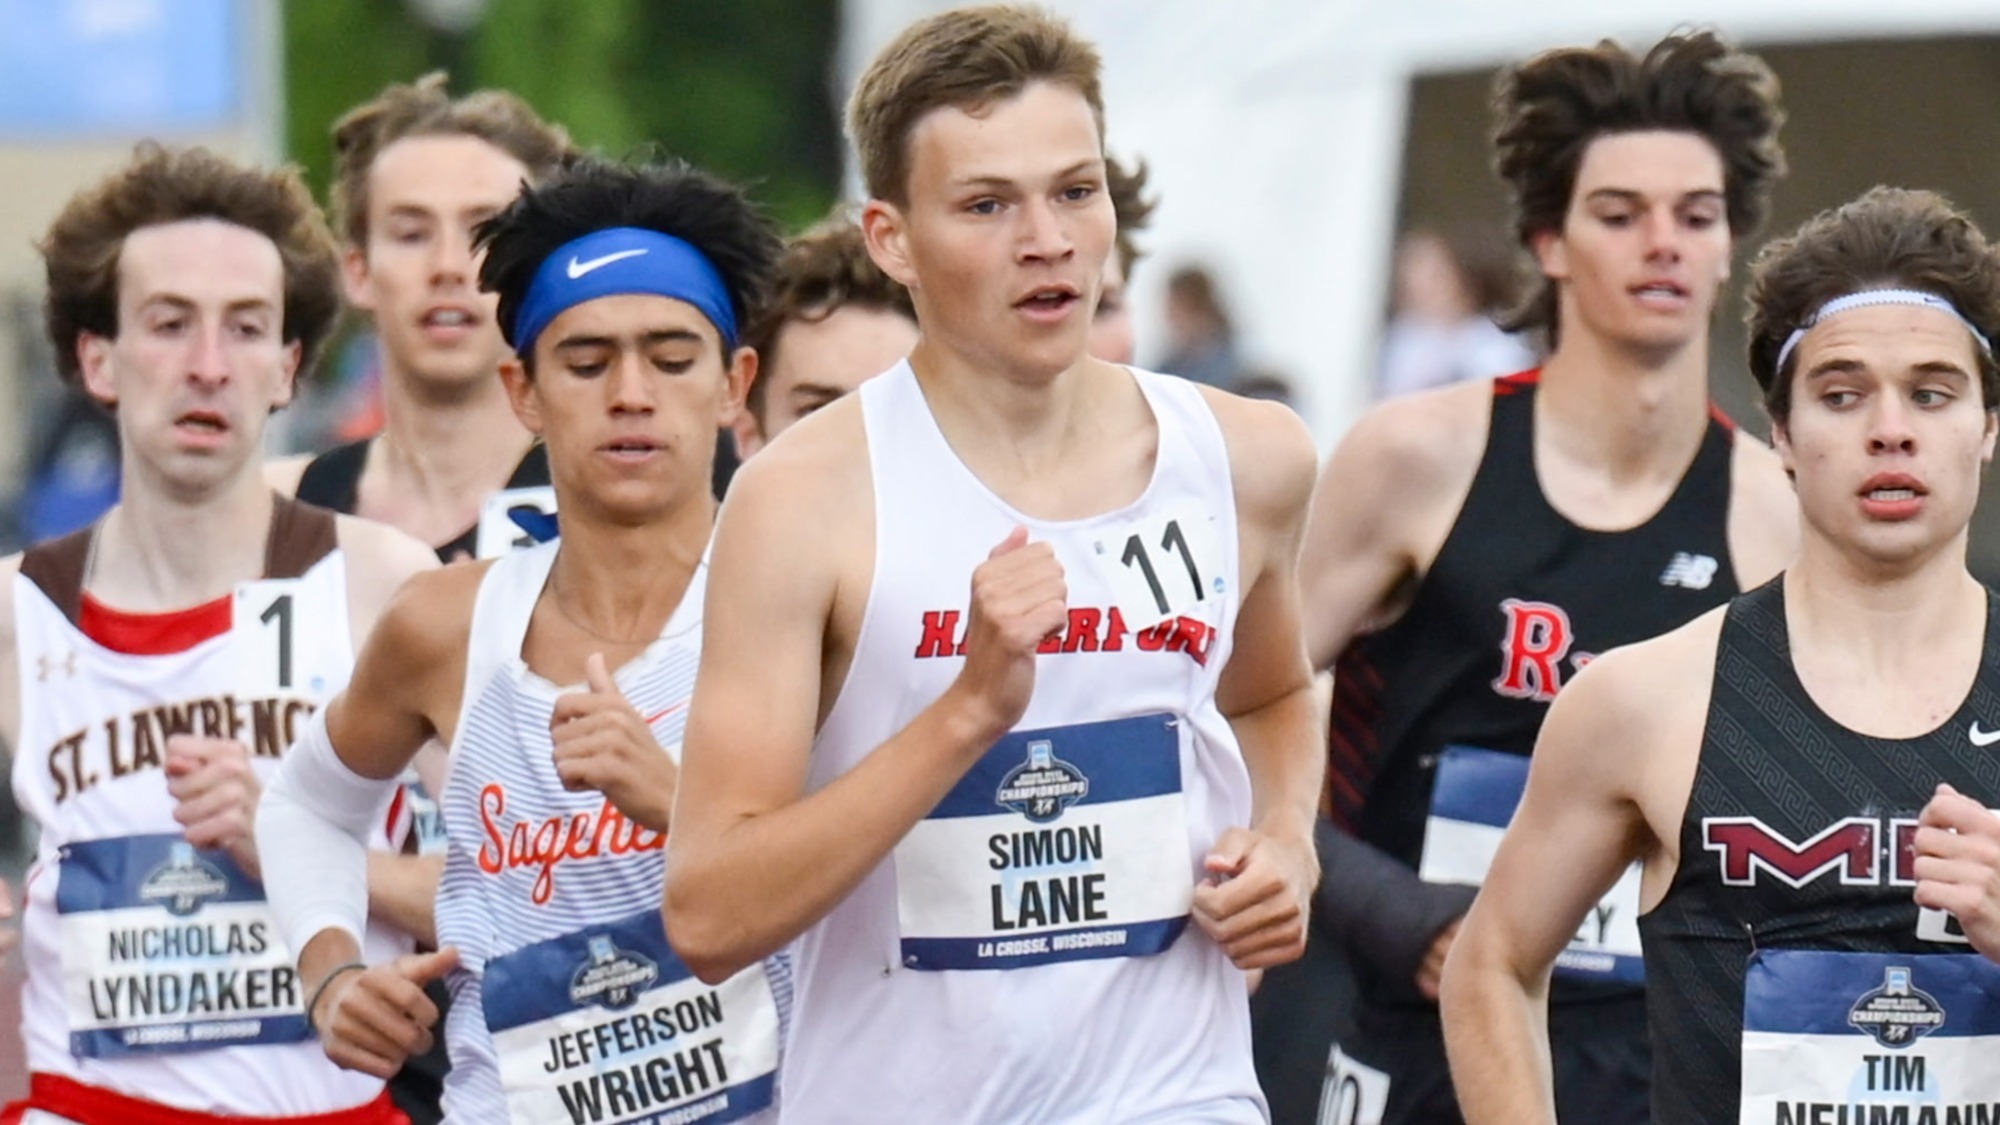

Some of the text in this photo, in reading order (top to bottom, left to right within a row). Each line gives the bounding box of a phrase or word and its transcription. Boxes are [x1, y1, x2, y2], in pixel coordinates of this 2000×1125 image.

[1120, 520, 1205, 616] 11
[259, 594, 293, 688] 1
[987, 824, 1103, 871] SIMON
[991, 873, 1108, 931] LANE
[108, 921, 267, 962] NICHOLAS
[977, 929, 1127, 958] LA CROSSE, WISCONSIN
[89, 965, 297, 1021] LYNDAKER
[543, 991, 724, 1075] JEFFERSON
[557, 1038, 728, 1125] WRIGHT
[1862, 1055, 1926, 1091] TIM
